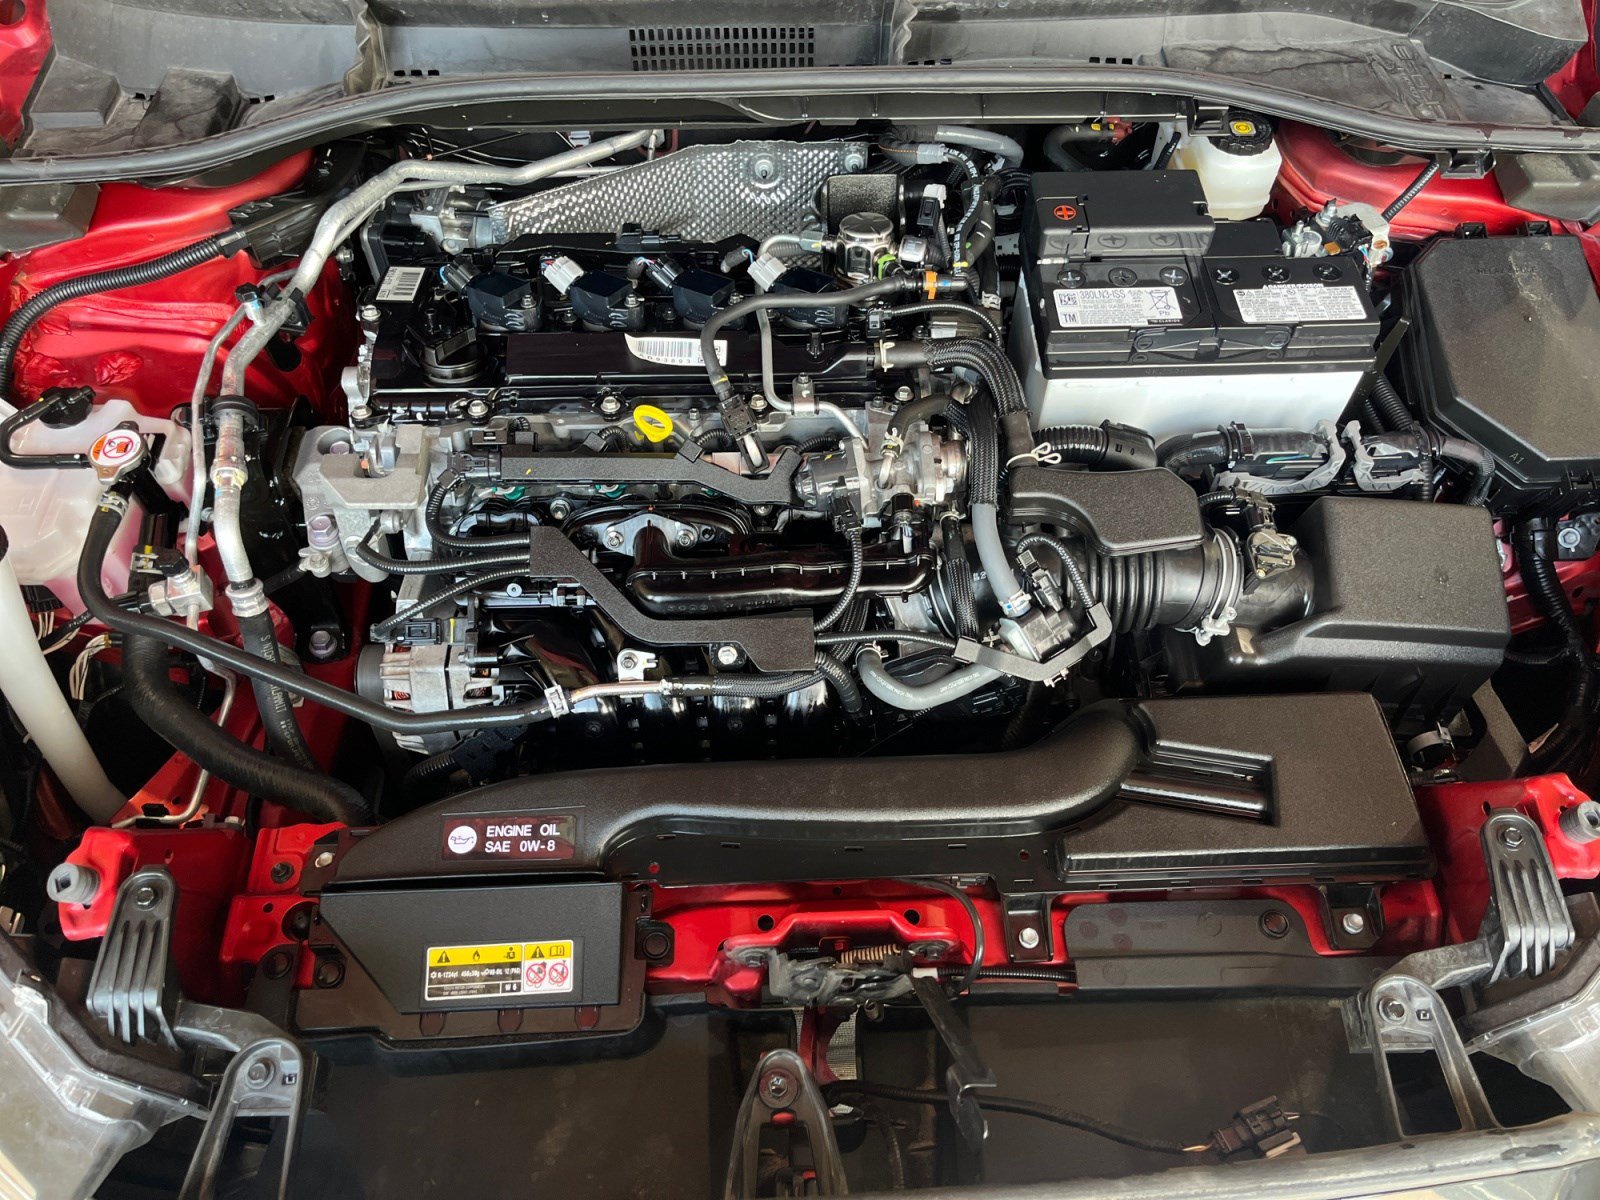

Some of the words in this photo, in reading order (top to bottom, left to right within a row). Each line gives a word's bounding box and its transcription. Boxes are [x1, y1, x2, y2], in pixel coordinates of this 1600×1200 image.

[1063, 313, 1077, 323] TM
[486, 825, 532, 837] ENGINE
[540, 824, 560, 836] OIL
[484, 841, 510, 853] SAE
[520, 840, 556, 852] 0W-8
